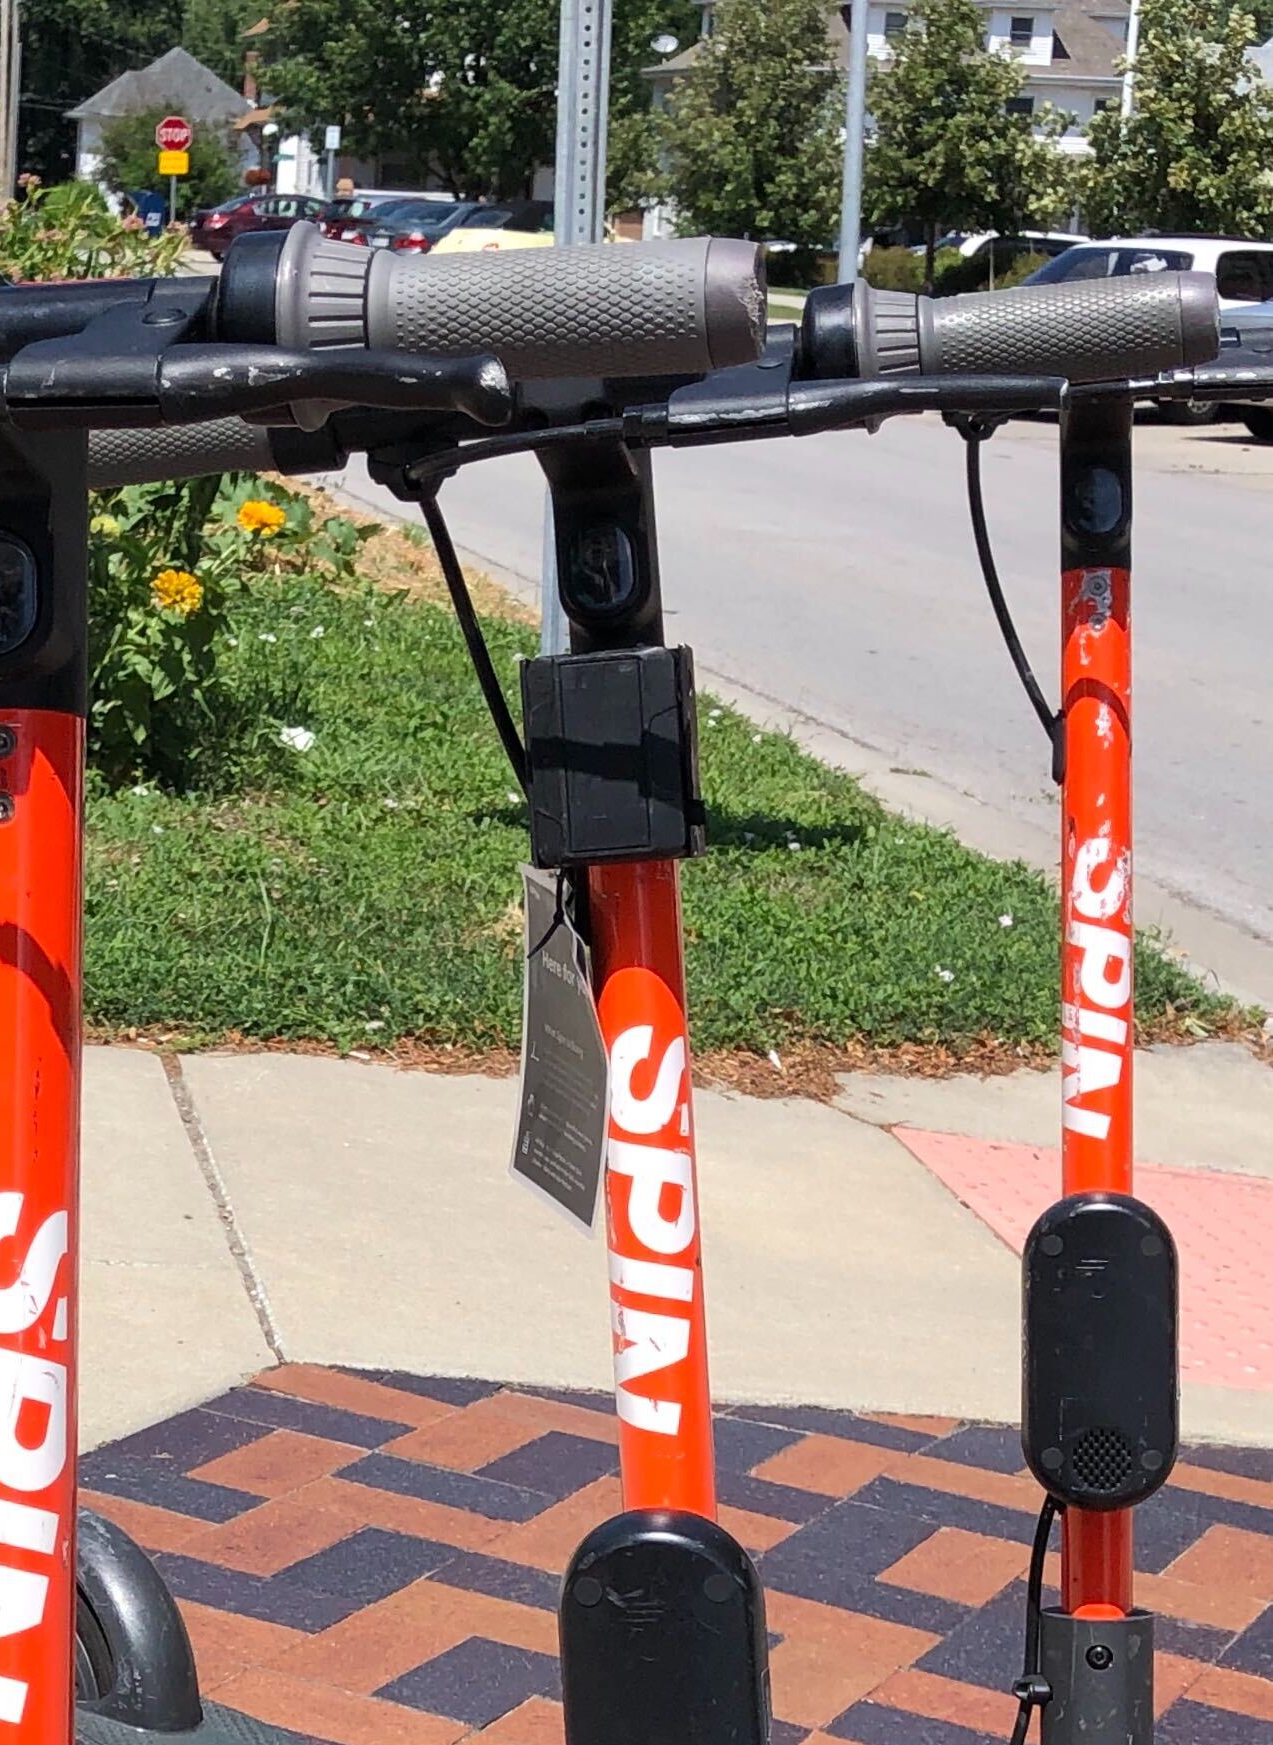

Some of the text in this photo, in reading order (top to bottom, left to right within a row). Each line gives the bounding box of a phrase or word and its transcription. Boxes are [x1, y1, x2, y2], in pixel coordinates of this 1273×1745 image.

[159, 127, 191, 143] STOP
[1062, 836, 1132, 1140] SPIN
[608, 1024, 696, 1436] SPIN
